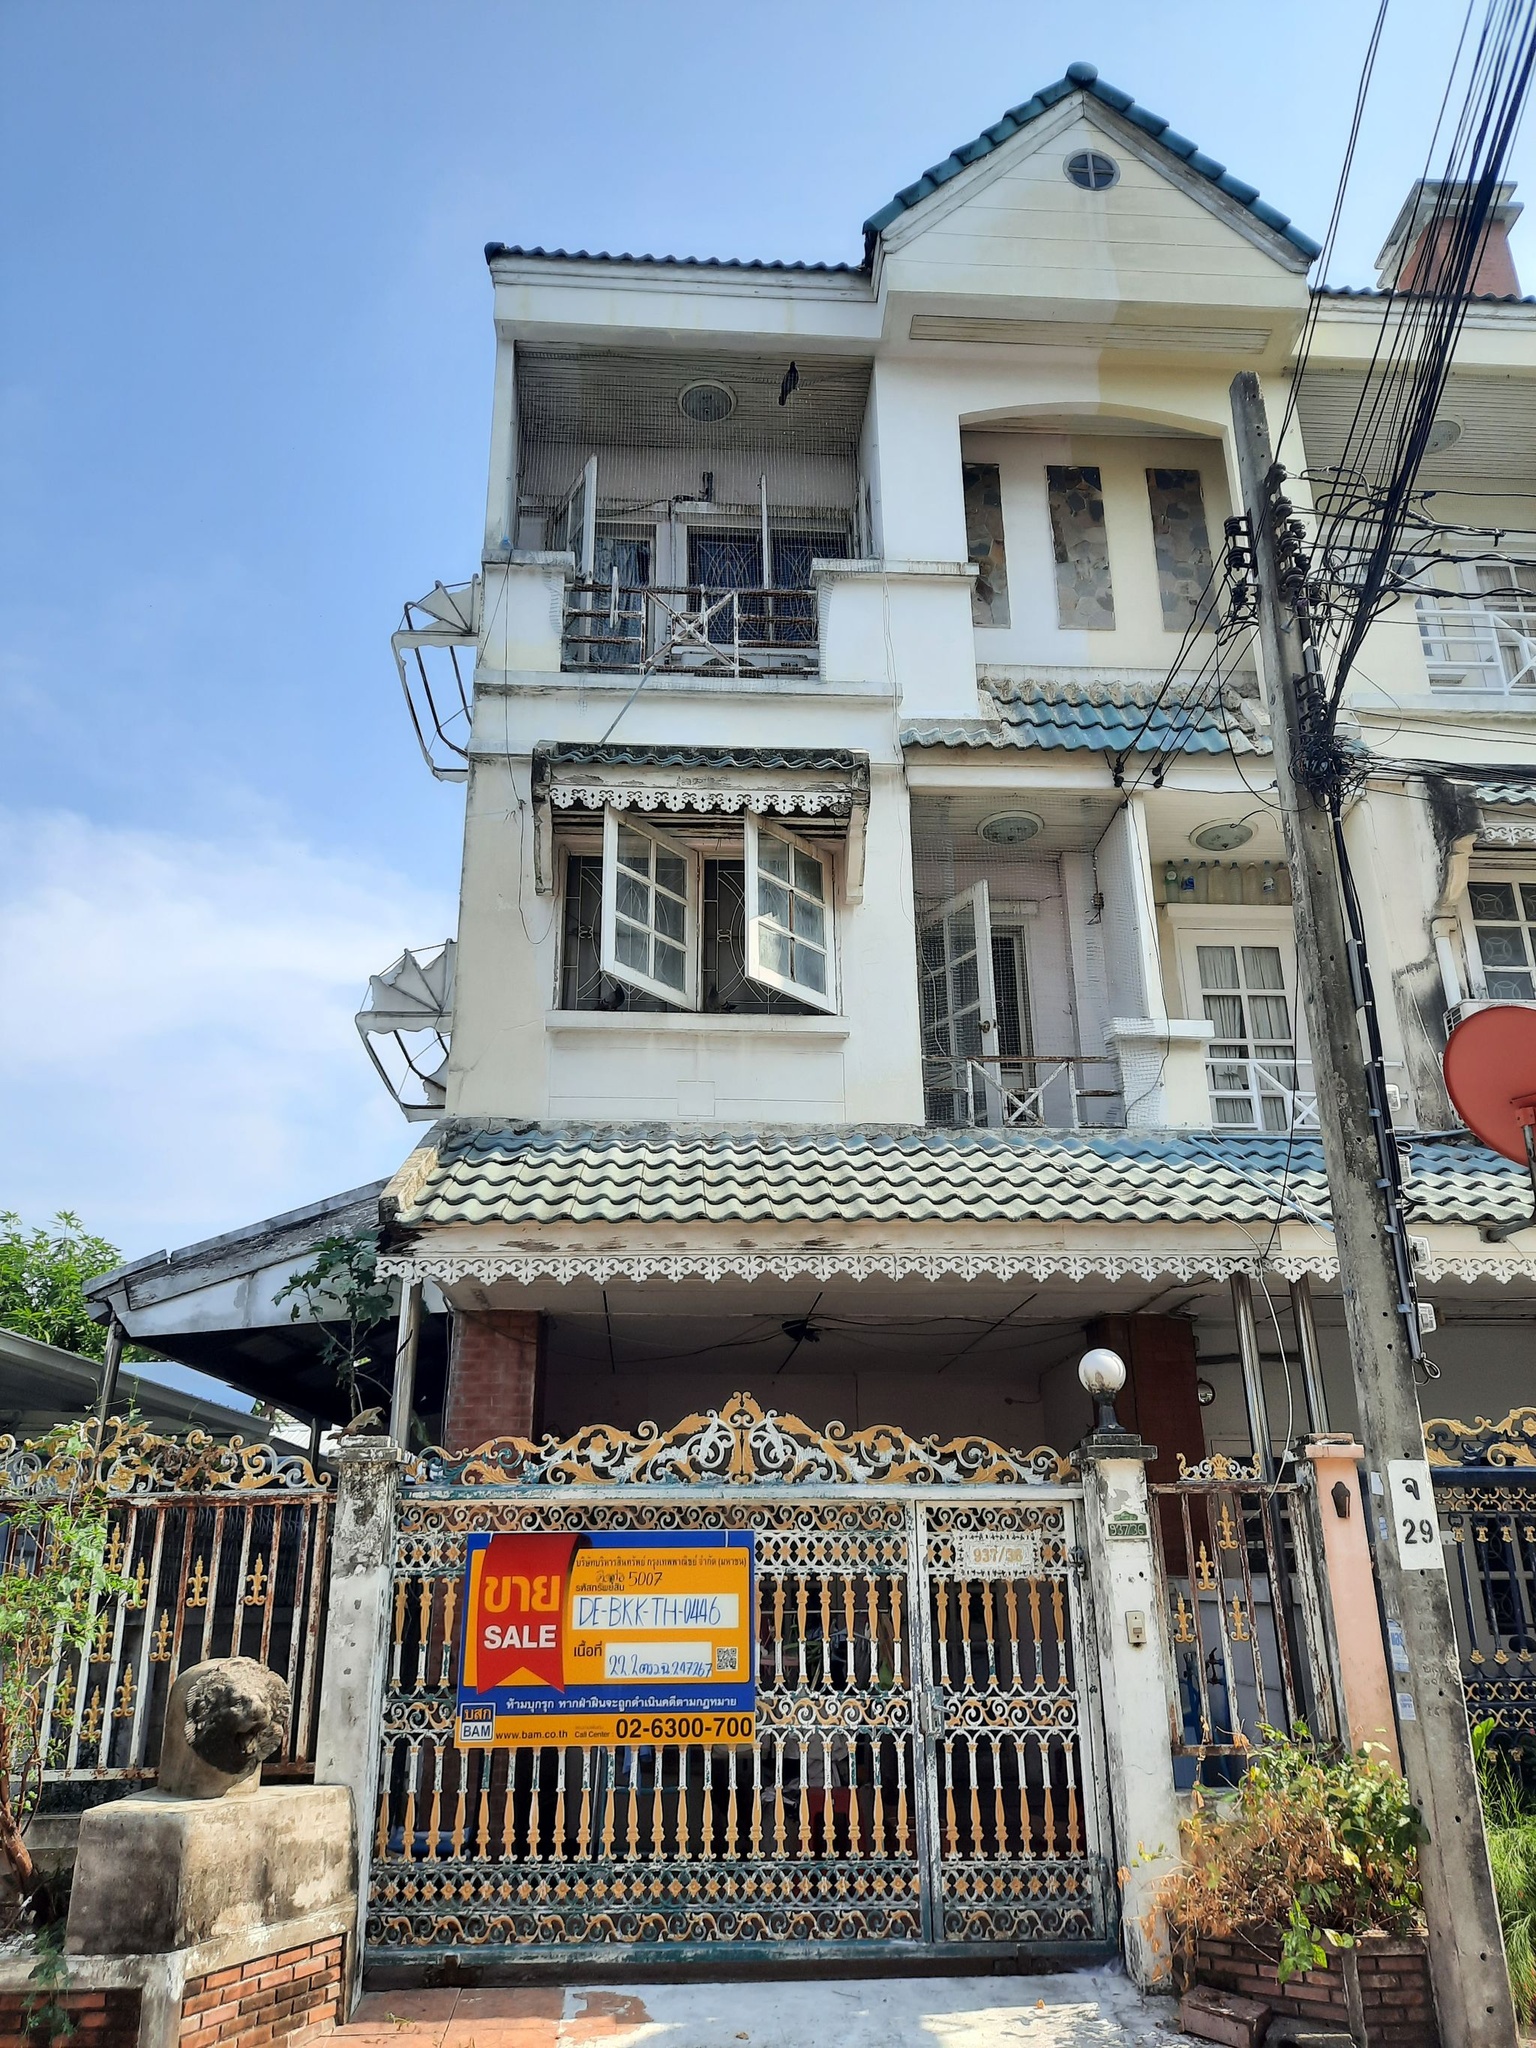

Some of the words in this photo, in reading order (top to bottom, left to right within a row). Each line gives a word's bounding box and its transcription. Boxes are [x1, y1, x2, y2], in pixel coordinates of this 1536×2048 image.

[1109, 1524, 1145, 1536] 937/36
[1403, 1519, 1433, 1544] 29
[629, 1571, 663, 1587] 5007
[484, 1575, 560, 1613] ขาย
[483, 1625, 557, 1650] SALE
[573, 1640, 603, 1657] เนื้อที่
[506, 1697, 555, 1714] ห้ามบุกรุก
[464, 1708, 492, 1721] บสก
[463, 1725, 491, 1738] BAM
[496, 1730, 568, 1740] www.bam.co.th
[616, 1716, 753, 1739] 02-6300-700
